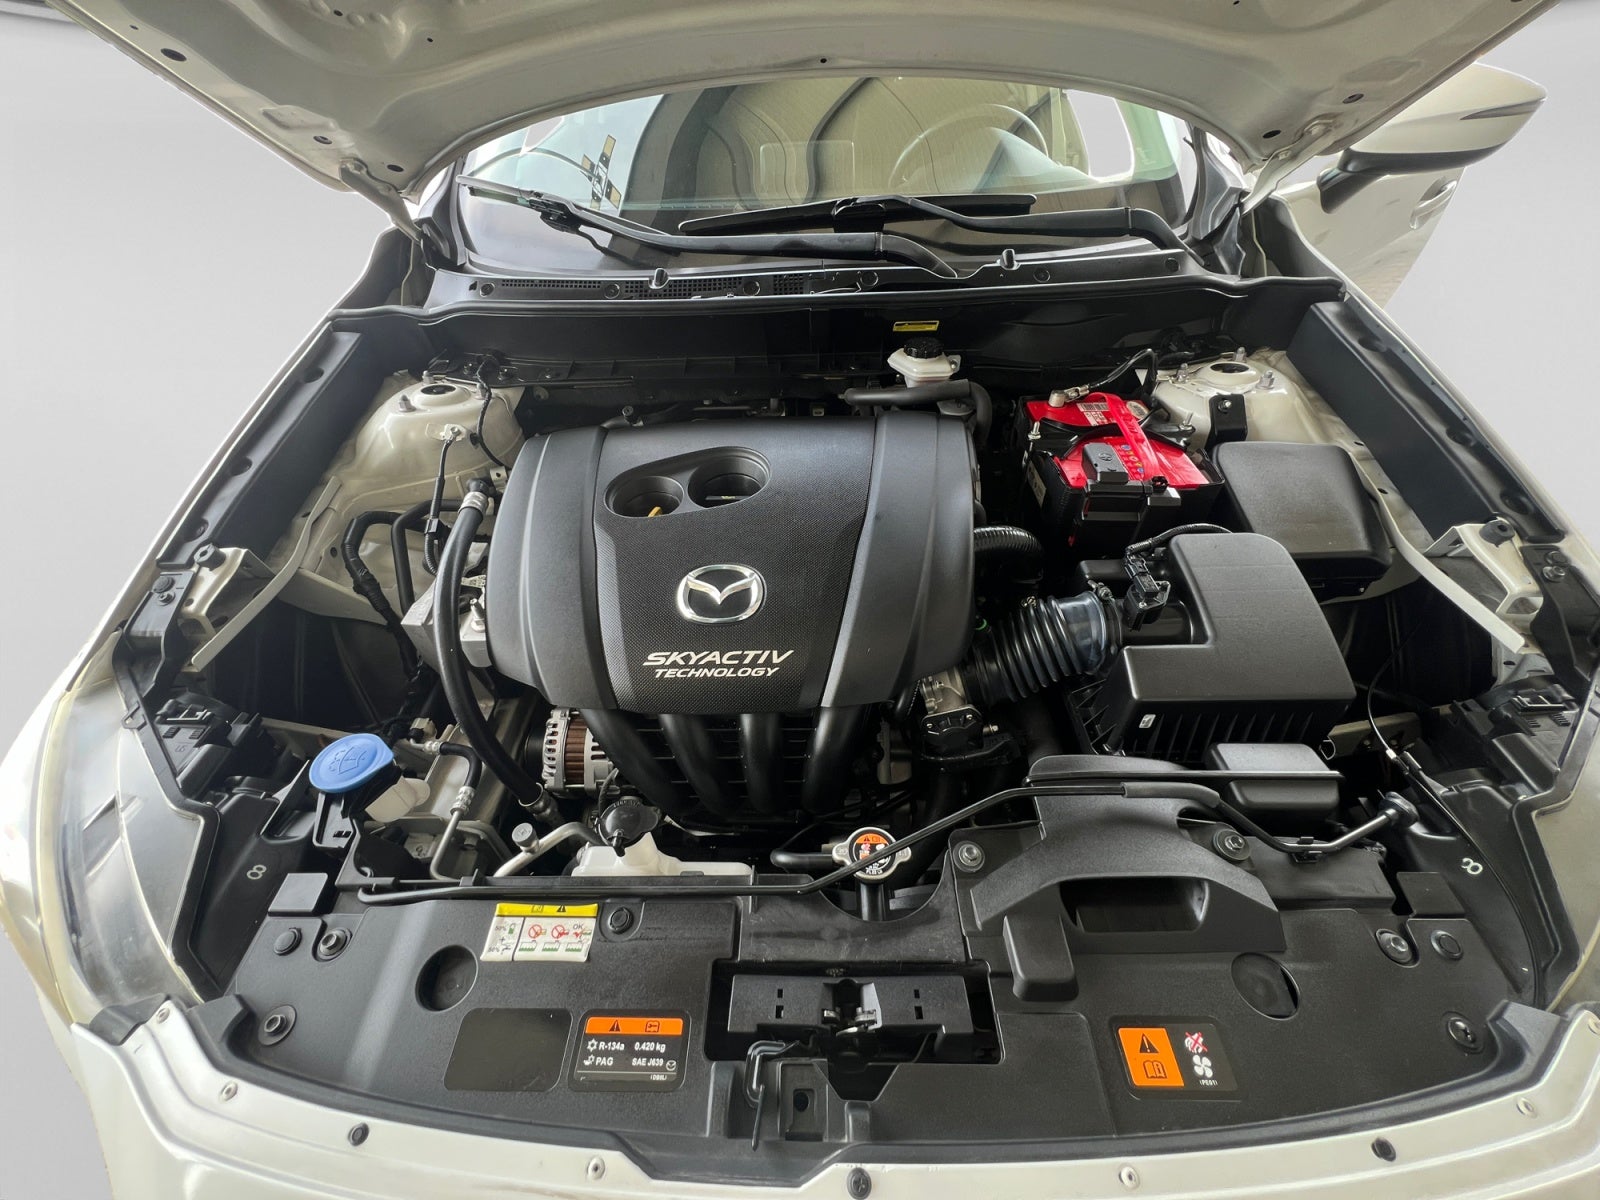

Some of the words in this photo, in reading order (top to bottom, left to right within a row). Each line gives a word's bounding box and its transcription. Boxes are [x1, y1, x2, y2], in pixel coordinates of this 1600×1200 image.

[643, 650, 794, 666] SKYACTIV
[655, 667, 780, 679] TECHNOLOGY
[598, 1041, 625, 1051] R-134a
[634, 1041, 655, 1051] 0.420
[656, 1041, 666, 1053] kg
[595, 1056, 614, 1066] PAG
[632, 1057, 646, 1066] SAE
[647, 1057, 664, 1066] J639
